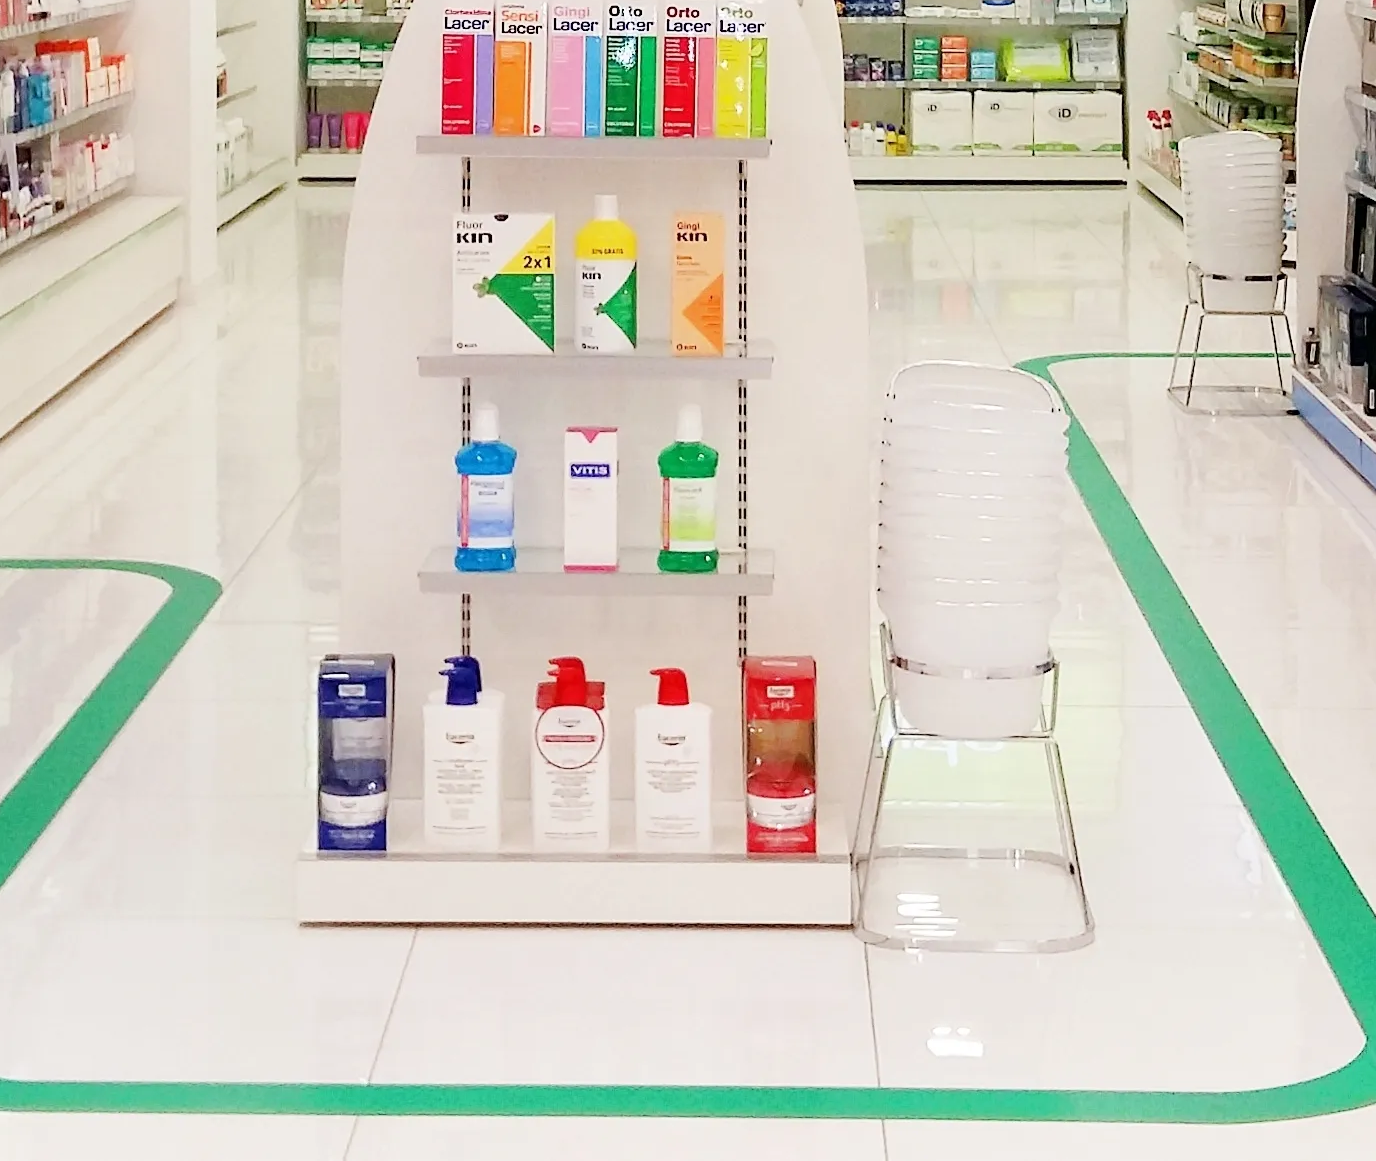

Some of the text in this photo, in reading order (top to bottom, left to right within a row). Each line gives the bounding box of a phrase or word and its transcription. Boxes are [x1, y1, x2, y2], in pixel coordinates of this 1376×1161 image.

[501, 10, 539, 23] Sensi
[553, 6, 591, 19] Gingi
[666, 6, 700, 18] Orto
[444, 16, 490, 30] Lacer
[501, 22, 543, 35] Lacer
[553, 18, 599, 32] Lacer
[608, 18, 654, 32] Lacer
[666, 19, 712, 33] Lacer
[719, 19, 766, 33] Lacer
[456, 220, 484, 230] Fluor
[677, 221, 700, 231] Gingi
[572, 465, 609, 475] VITIS
